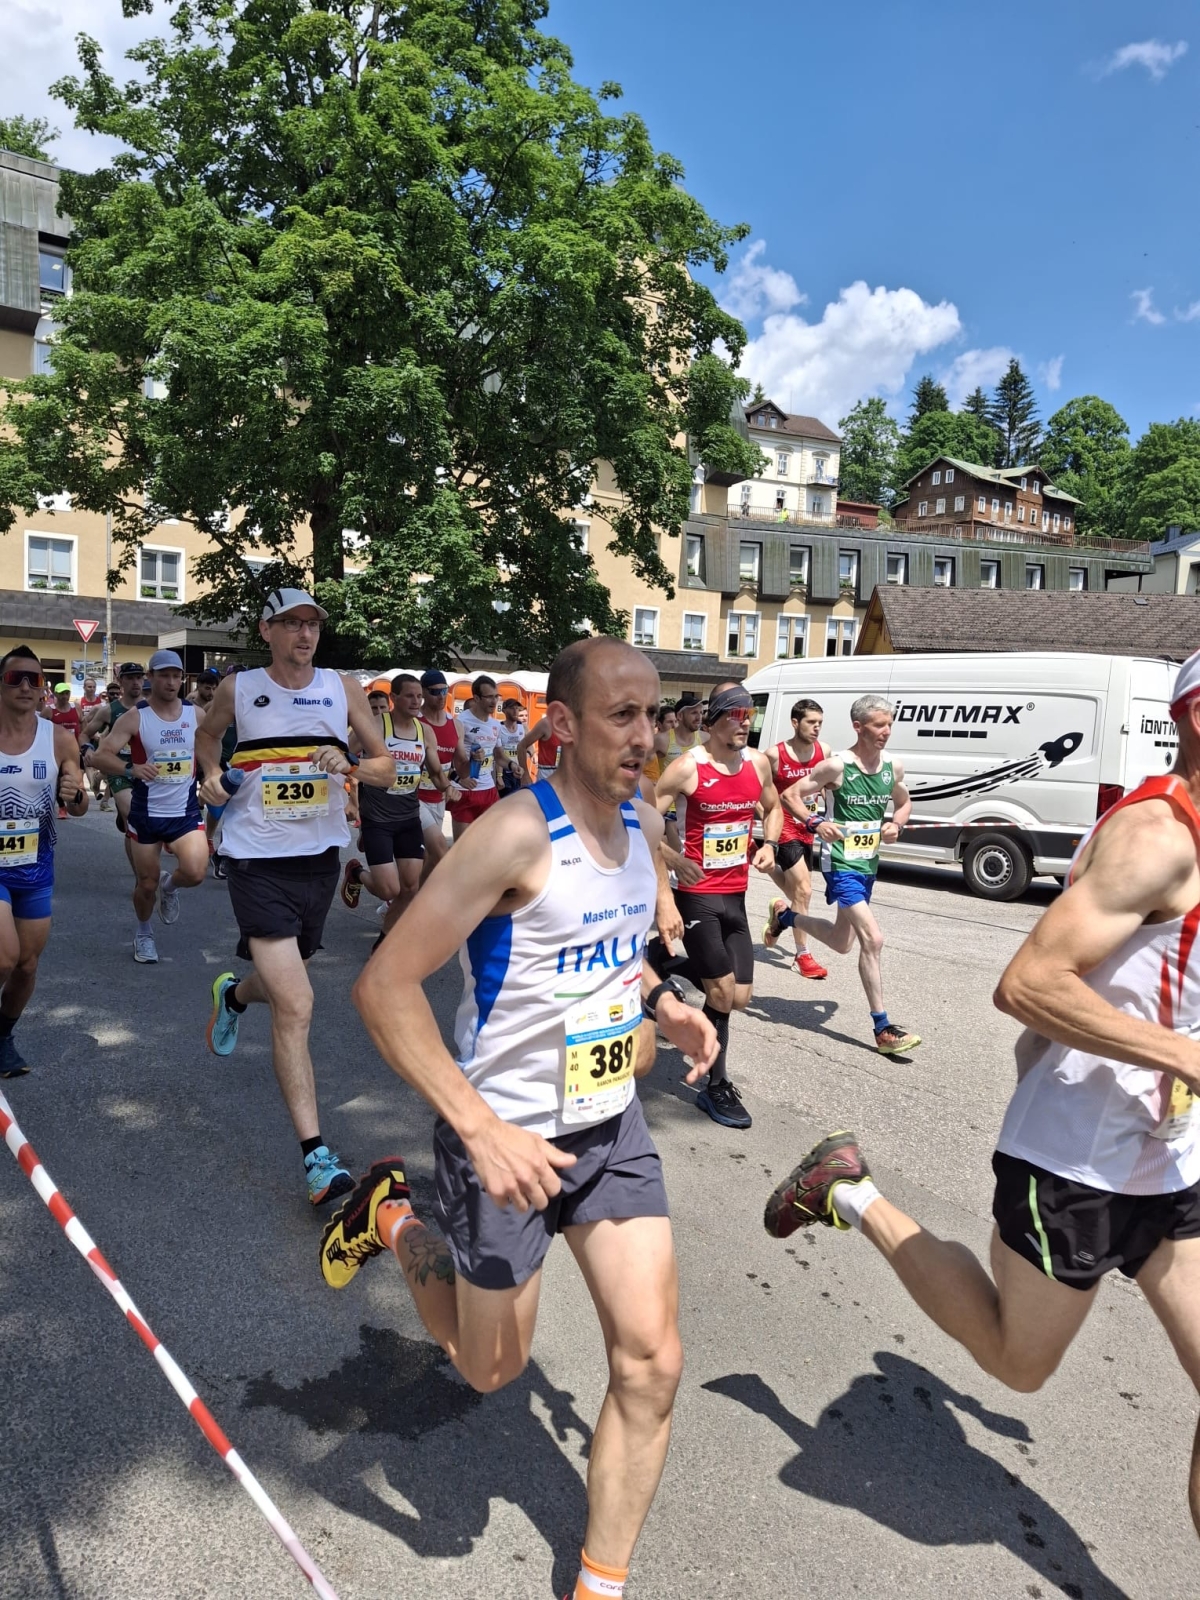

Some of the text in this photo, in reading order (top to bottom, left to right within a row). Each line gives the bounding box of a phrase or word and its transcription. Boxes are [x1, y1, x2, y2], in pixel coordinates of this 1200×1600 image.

[293, 698, 321, 706] Allianz
[160, 729, 183, 737] GREAT
[160, 737, 186, 745] BRITAIN
[166, 762, 182, 772] 34
[397, 775, 414, 785] 524
[276, 782, 315, 801] 230
[847, 794, 889, 805] IRELAND
[716, 837, 738, 853] 561
[853, 834, 874, 846] 936
[582, 903, 647, 925] Master Team
[557, 932, 647, 974] ITALI
[571, 1051, 578, 1060] M
[589, 1035, 633, 1079] 389
[569, 1063, 579, 1072] 40
